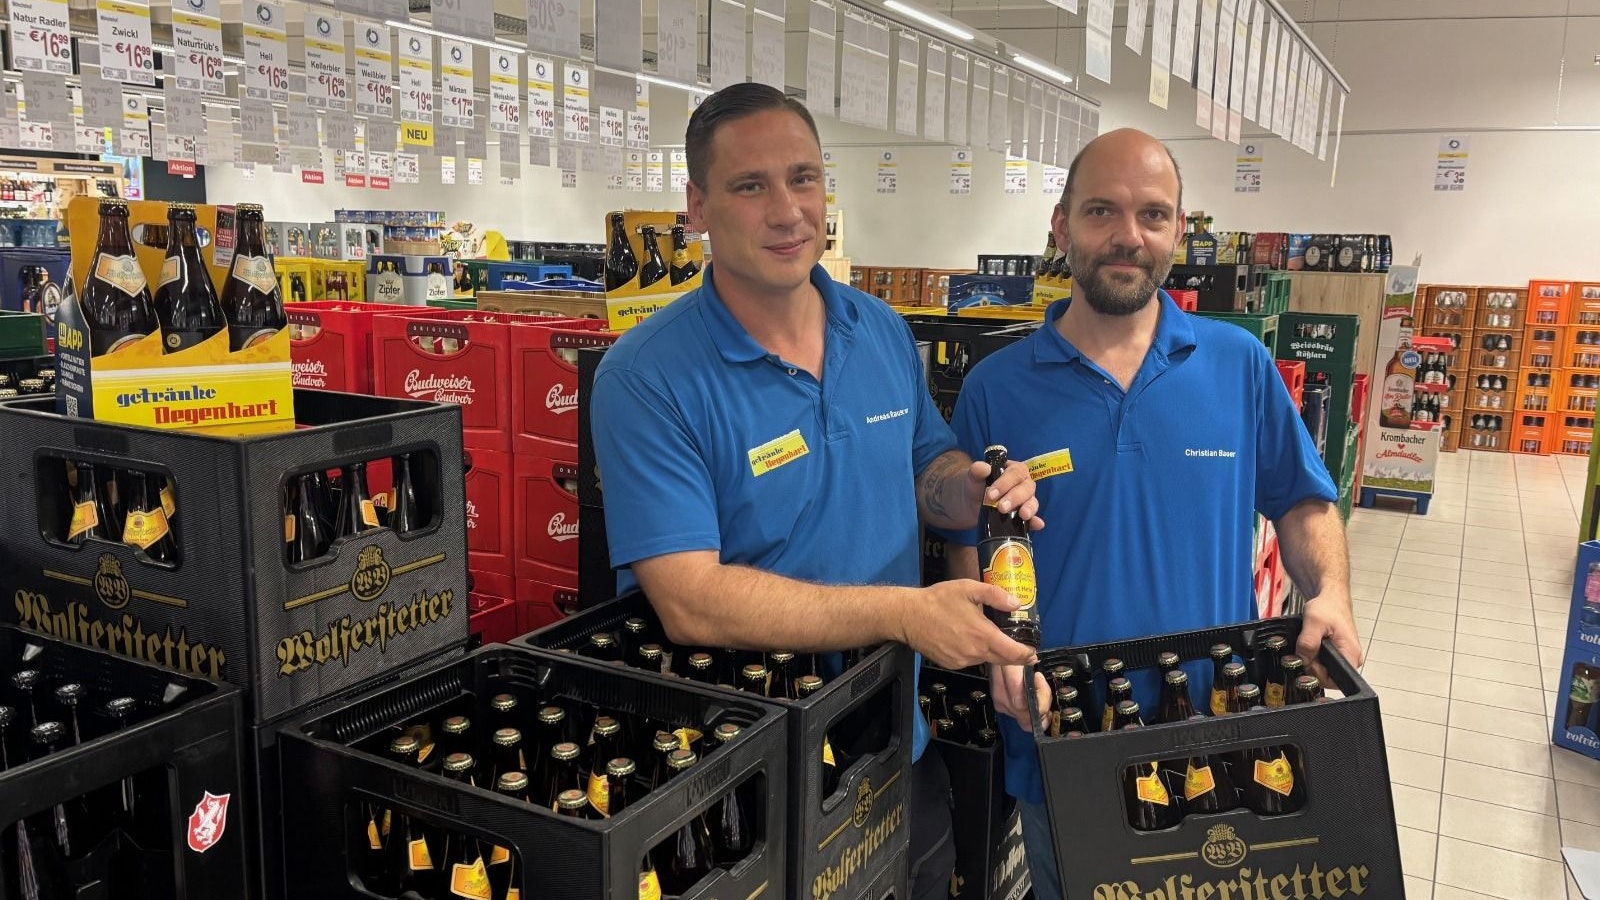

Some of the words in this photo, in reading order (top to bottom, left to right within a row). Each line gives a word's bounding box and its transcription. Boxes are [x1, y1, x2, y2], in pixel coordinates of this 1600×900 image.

[13, 12, 37, 24] Natur
[39, 16, 67, 28] Radler
[112, 26, 138, 39] Zwickl
[177, 37, 219, 52] Naturtrüb's
[259, 51, 273, 62] Hell
[310, 60, 341, 73] Kellerbier
[406, 128, 428, 140] NEU
[171, 162, 193, 173] Aktion
[378, 284, 401, 296] Zipfer
[290, 359, 327, 376] weiser
[404, 369, 475, 398] Budweiser
[116, 385, 216, 408] getränke
[434, 387, 473, 405] Budvar
[153, 400, 278, 425] Degenhart
[1380, 431, 1426, 445] Krombacher
[1184, 448, 1218, 457] Christian
[1375, 449, 1424, 464] Almdudler
[1566, 730, 1600, 749] volvic
